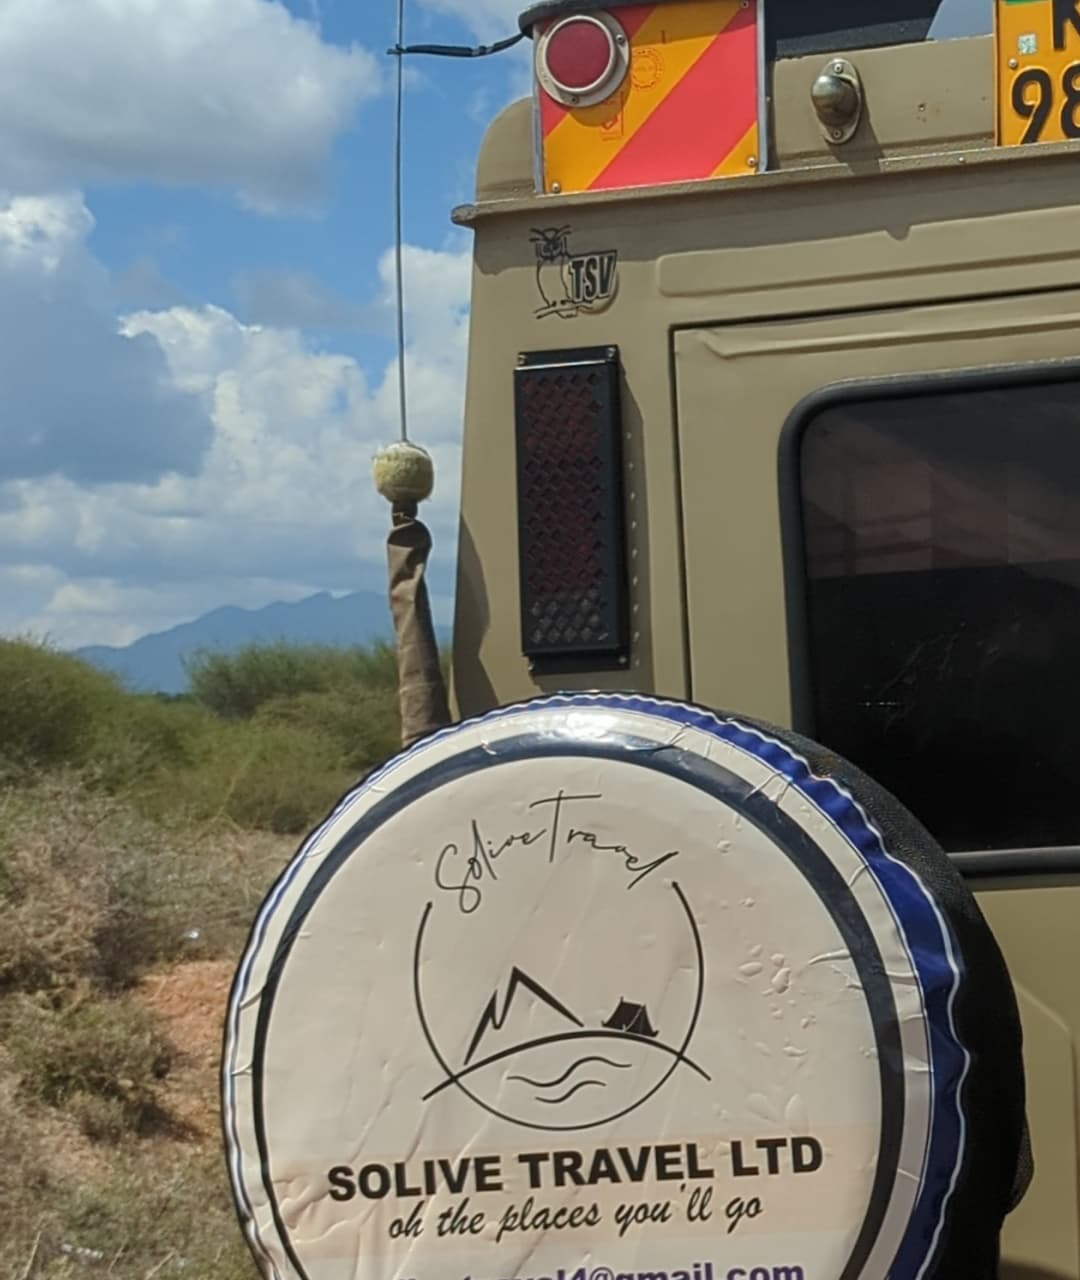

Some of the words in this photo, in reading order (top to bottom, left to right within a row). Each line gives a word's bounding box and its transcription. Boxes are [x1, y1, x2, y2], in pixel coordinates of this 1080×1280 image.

[571, 255, 614, 302] TSV
[327, 1156, 504, 1201] SOLIVE
[518, 1143, 715, 1189] TRAVEL
[730, 1136, 823, 1177] LTD
[388, 1200, 425, 1239] oh
[436, 1197, 486, 1237] the
[495, 1196, 602, 1243] places
[615, 1183, 714, 1237] you'll
[725, 1196, 763, 1234] go
